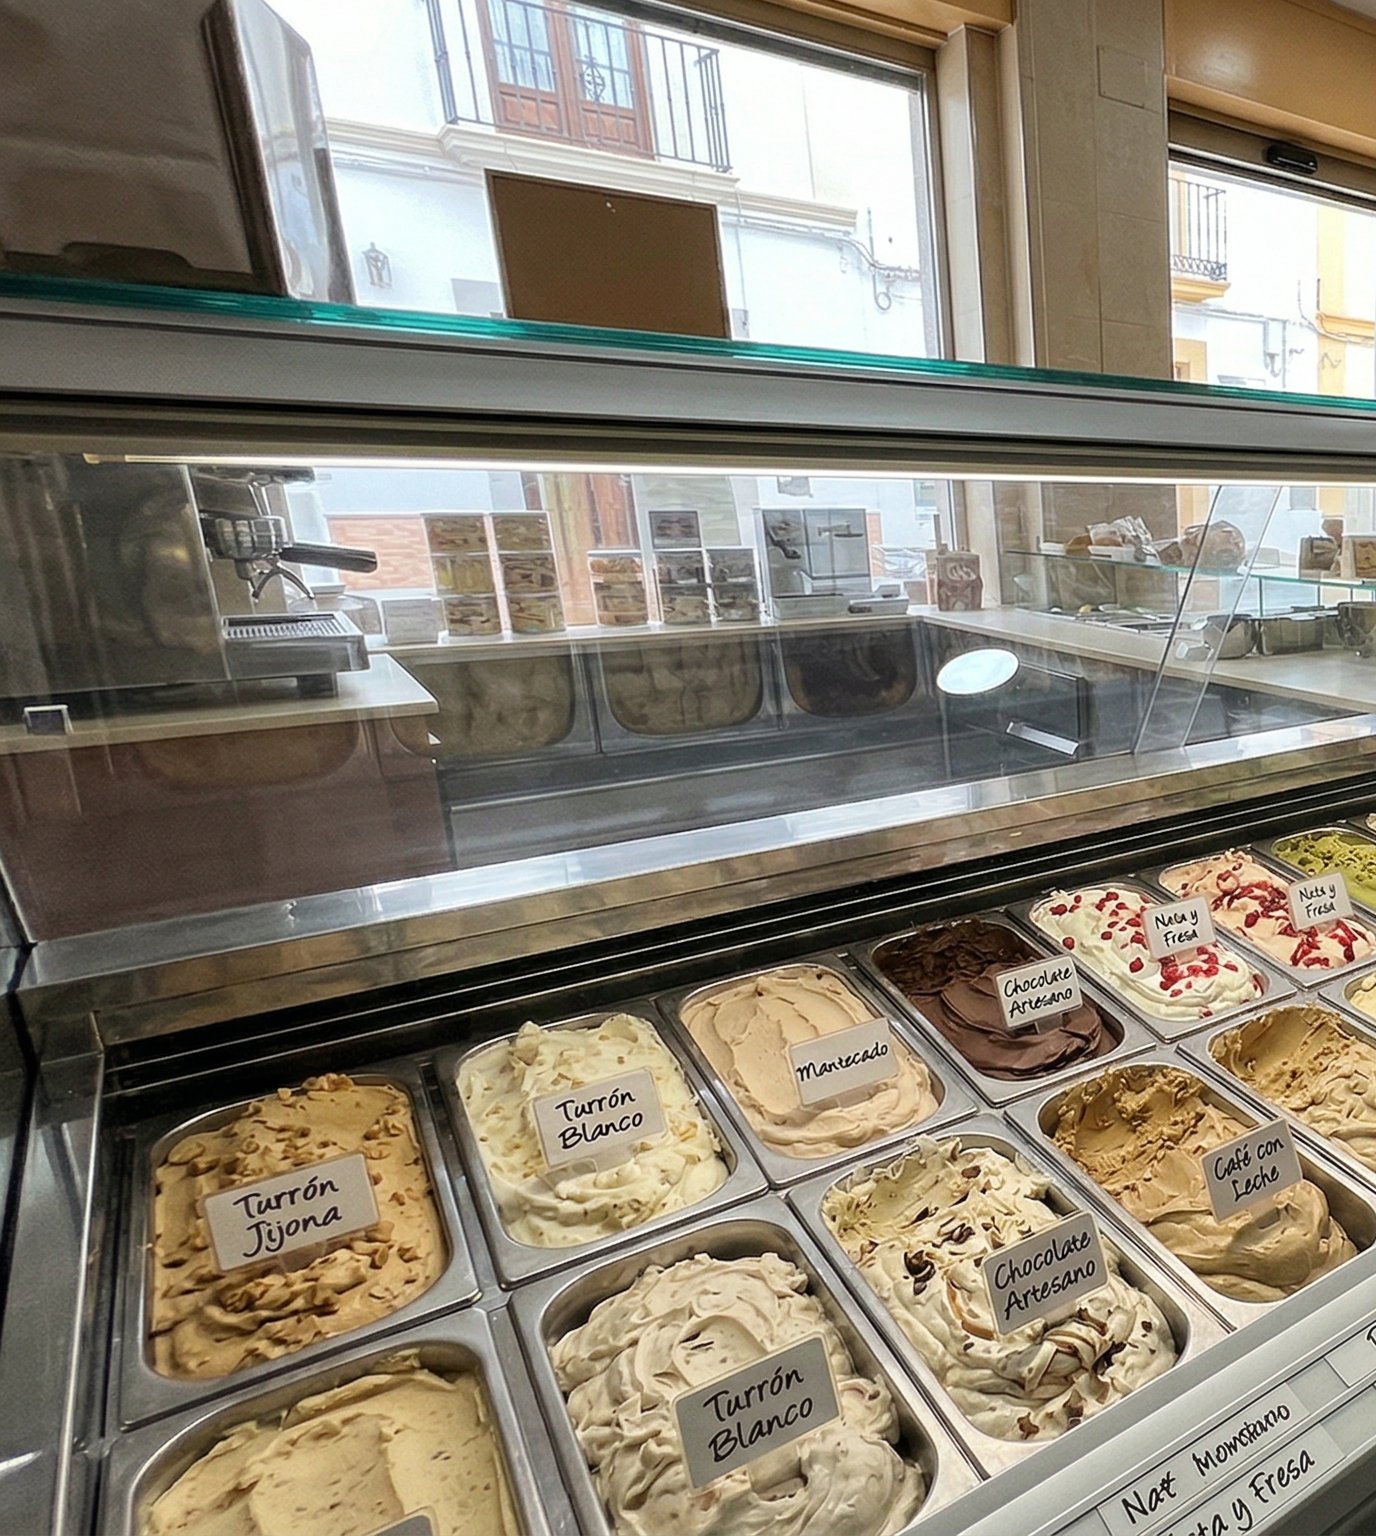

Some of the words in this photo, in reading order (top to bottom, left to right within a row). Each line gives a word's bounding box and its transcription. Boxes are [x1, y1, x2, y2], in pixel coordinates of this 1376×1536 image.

[1163, 929, 1198, 947] Fresa
[1004, 967, 1072, 998] Chocolate
[1009, 988, 1072, 1019] Artesano
[796, 1041, 888, 1082] Mantecado
[555, 1087, 636, 1122] Turrón
[558, 1112, 643, 1149] Blanco
[1214, 1143, 1251, 1180] Café
[1257, 1138, 1284, 1160] con
[233, 1175, 339, 1219] Turrón
[1231, 1165, 1279, 1202] Leche
[243, 1206, 342, 1258] Jijona
[994, 1231, 1091, 1290] Chocolate
[1004, 1260, 1096, 1321] Artesano
[703, 1366, 804, 1422] Turrón
[708, 1397, 814, 1463] Blanco
[1232, 1498, 1253, 1532] y
[1248, 1450, 1316, 1504] Fresa
